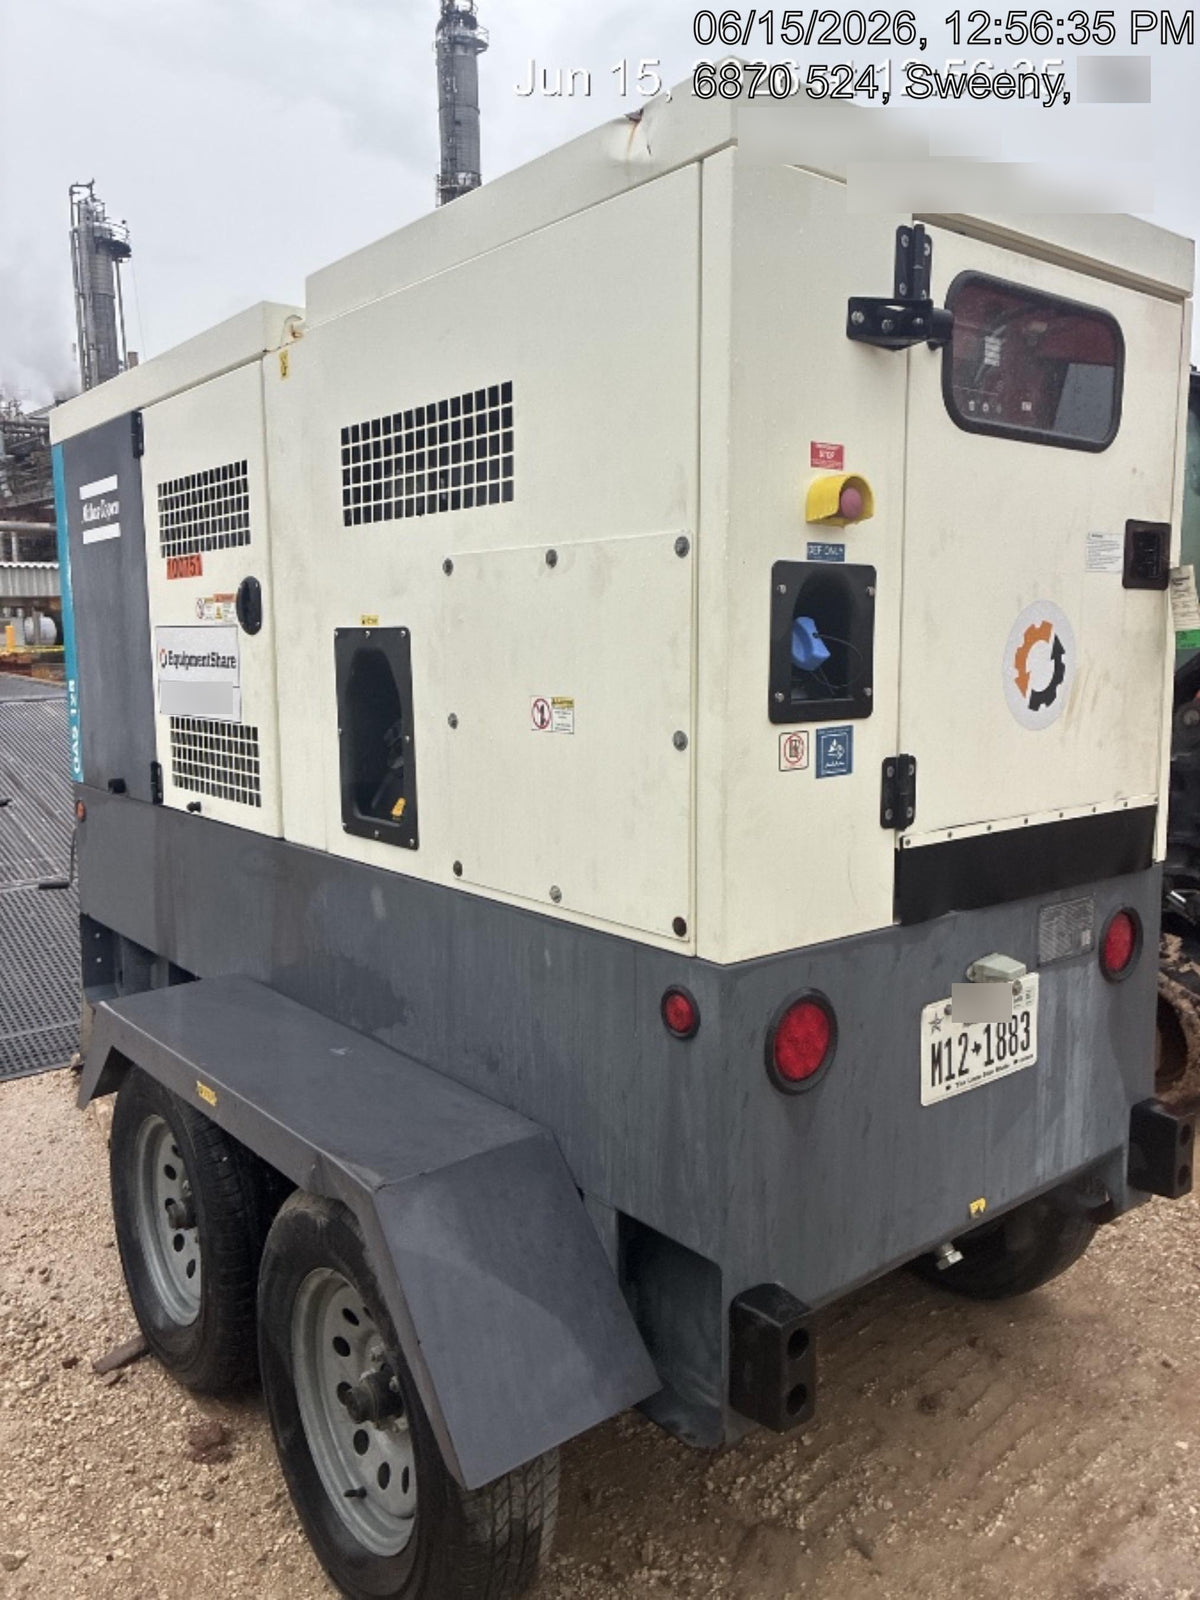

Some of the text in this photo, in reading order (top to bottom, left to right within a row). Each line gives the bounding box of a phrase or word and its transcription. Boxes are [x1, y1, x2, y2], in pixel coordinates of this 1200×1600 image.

[168, 650, 237, 671] EquipmentShare
[931, 1032, 969, 1087] M12
[983, 1010, 1031, 1067] 1883
